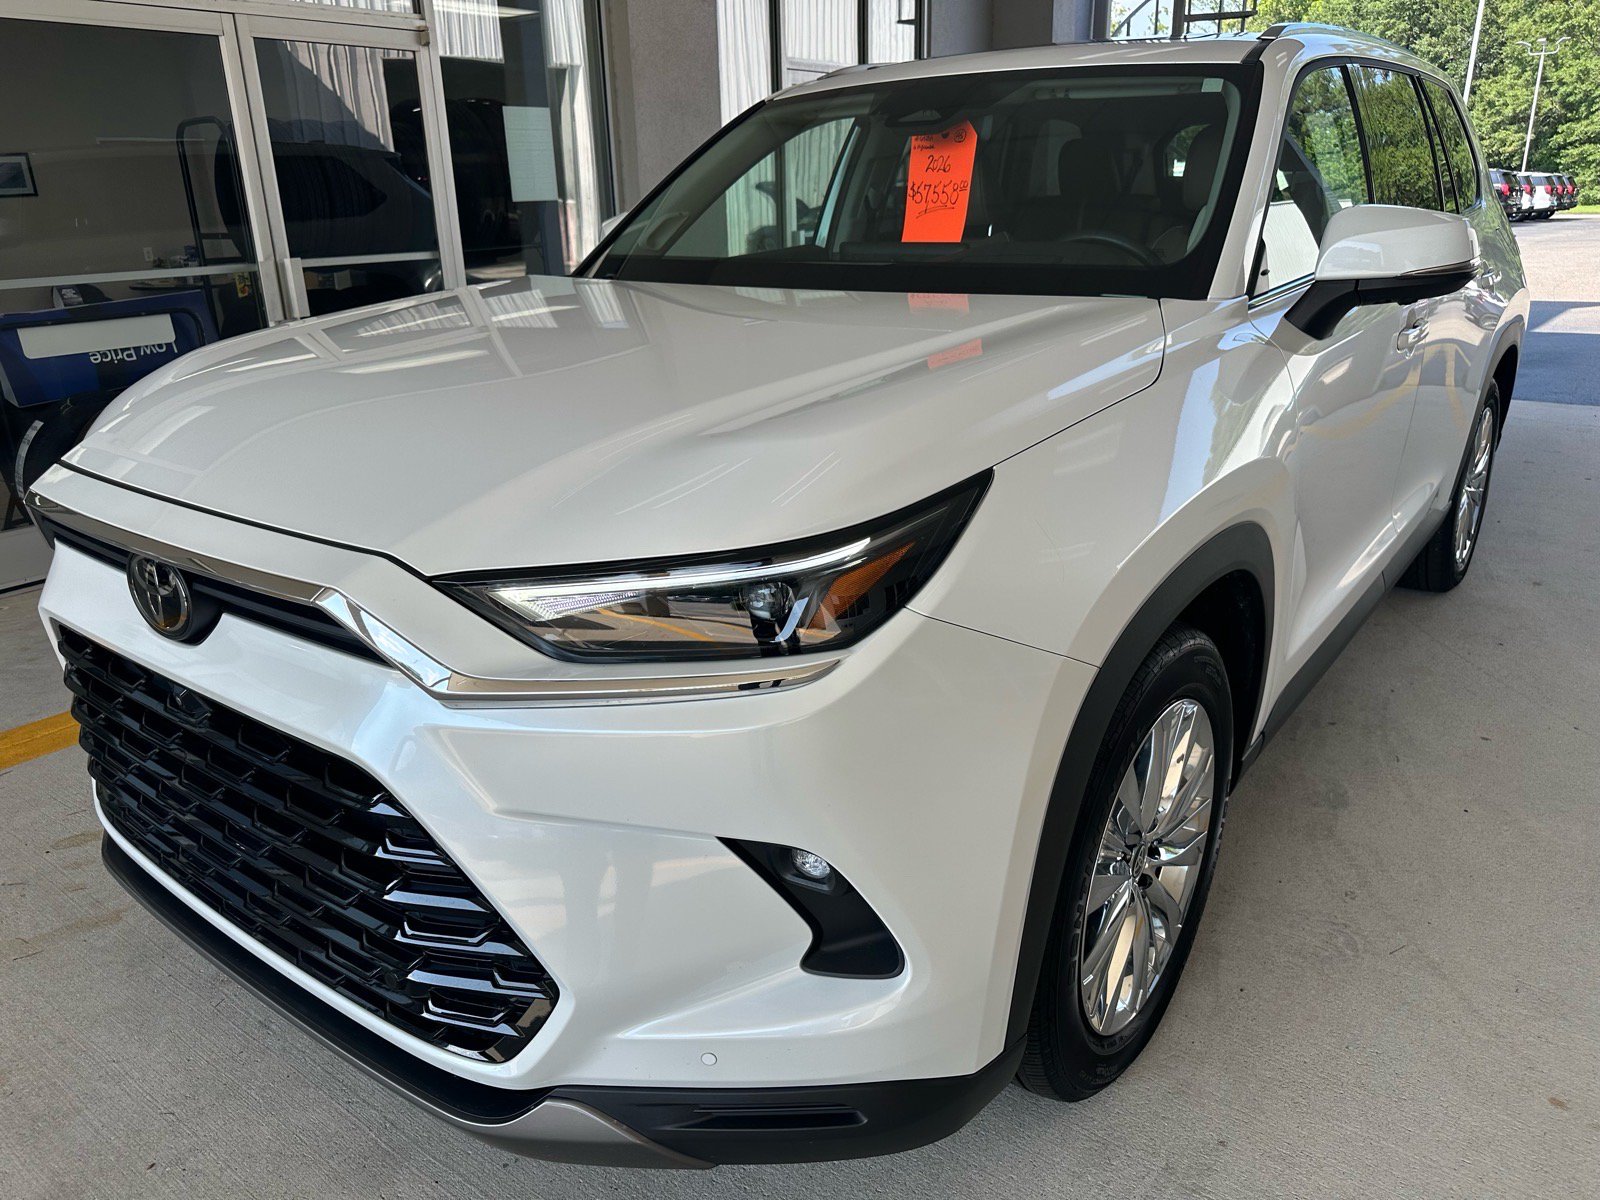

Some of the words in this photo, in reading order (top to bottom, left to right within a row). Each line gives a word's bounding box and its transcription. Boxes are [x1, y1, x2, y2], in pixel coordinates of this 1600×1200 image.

[925, 154, 952, 173] 2026
[88, 347, 137, 364] Price
[140, 341, 178, 355] Low
